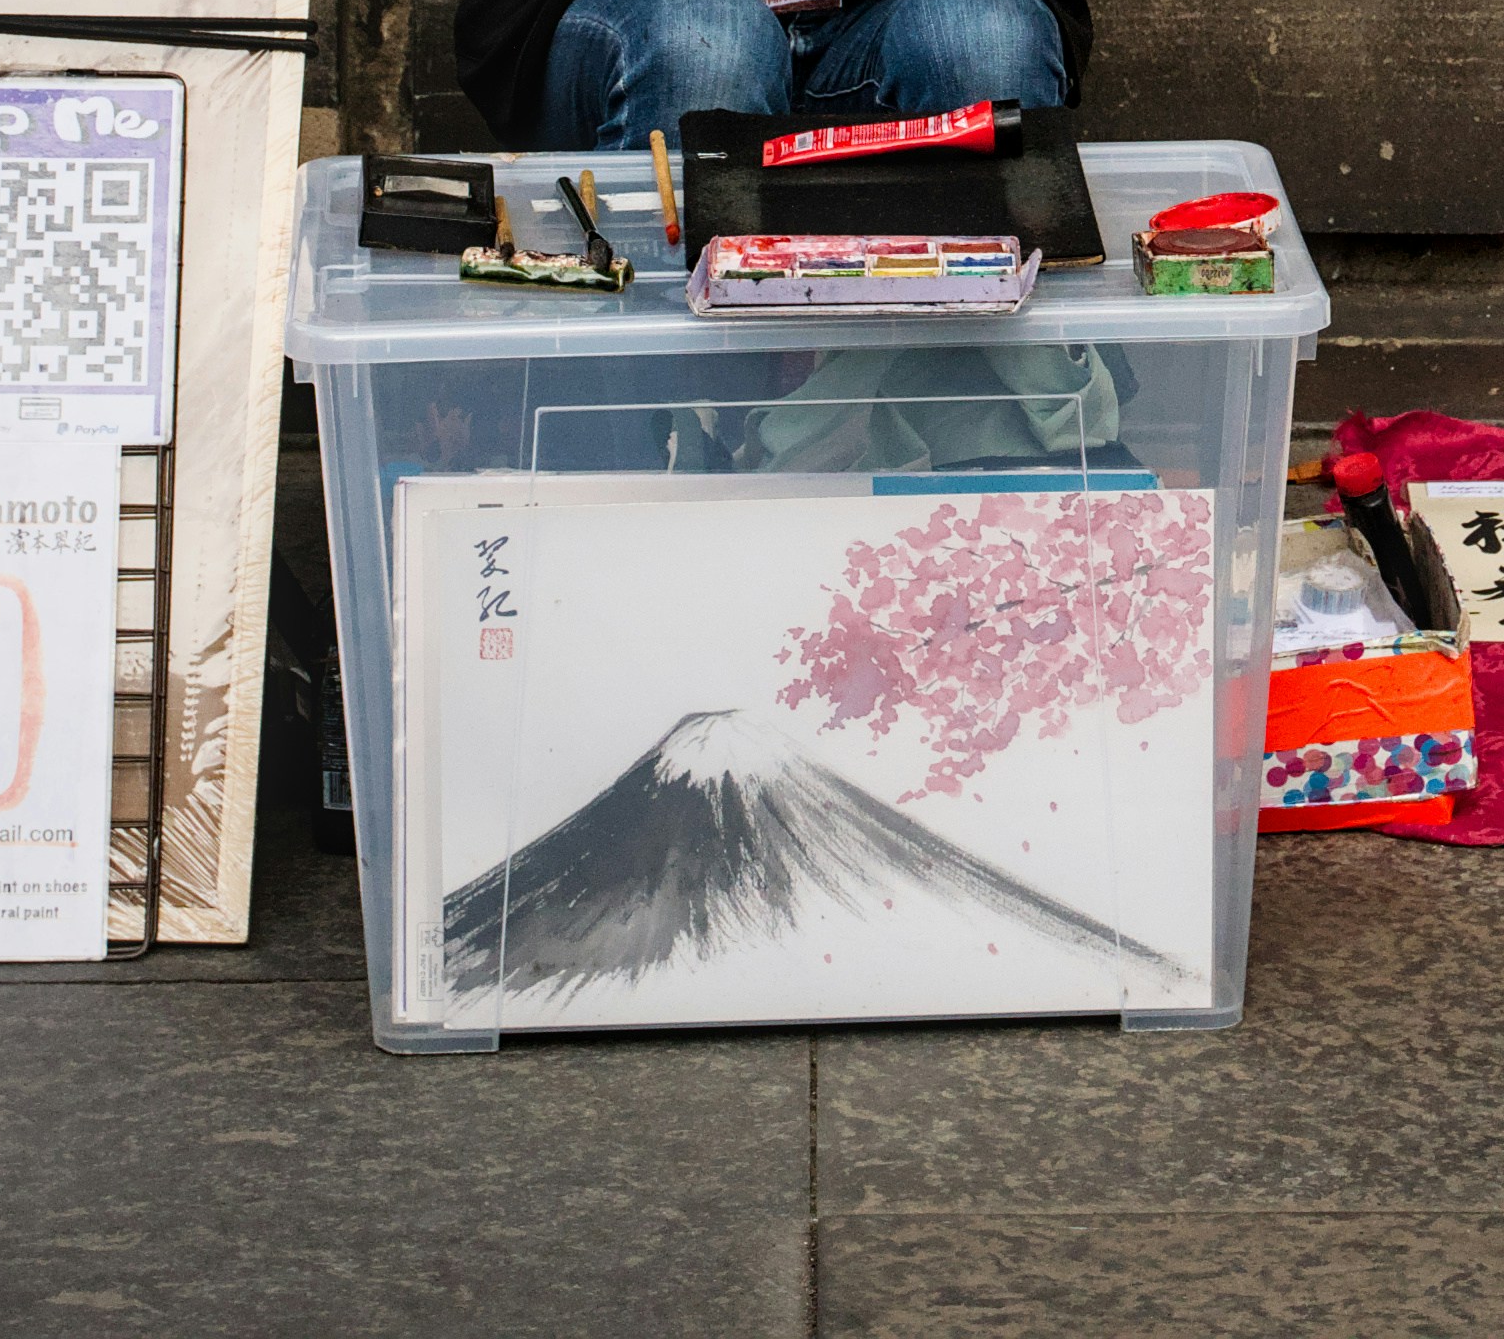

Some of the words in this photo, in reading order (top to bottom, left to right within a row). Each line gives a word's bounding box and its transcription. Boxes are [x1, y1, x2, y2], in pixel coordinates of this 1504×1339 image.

[53, 95, 159, 142] Me
[74, 424, 120, 435] PayPal
[22, 882, 41, 894] on
[45, 879, 89, 894] shoes
[26, 905, 61, 922] paint
